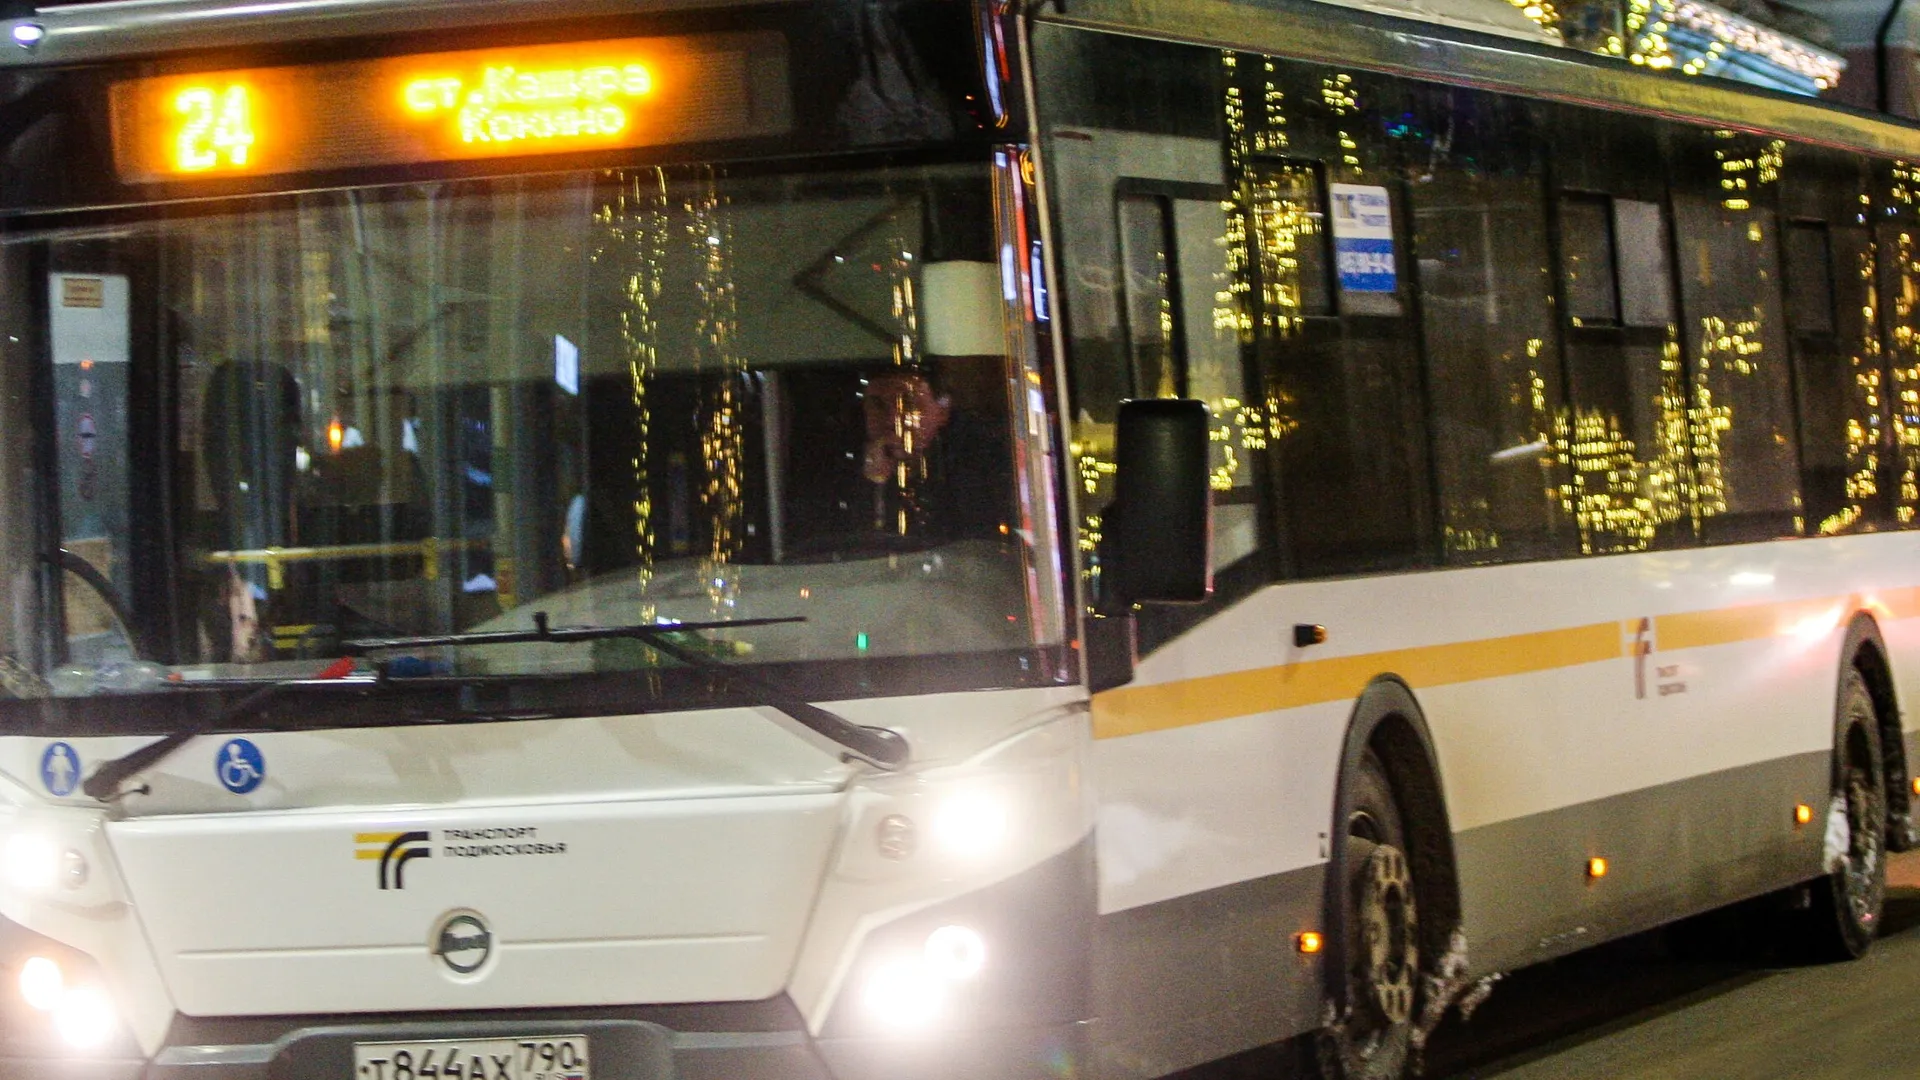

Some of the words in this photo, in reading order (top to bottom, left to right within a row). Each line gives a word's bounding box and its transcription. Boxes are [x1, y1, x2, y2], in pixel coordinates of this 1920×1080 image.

[175, 85, 255, 170] 24
[442, 826, 538, 841] ТРАНСПОРТ
[443, 842, 567, 858] ПОДМОСКОВЬЯ
[518, 1041, 576, 1072] 790
